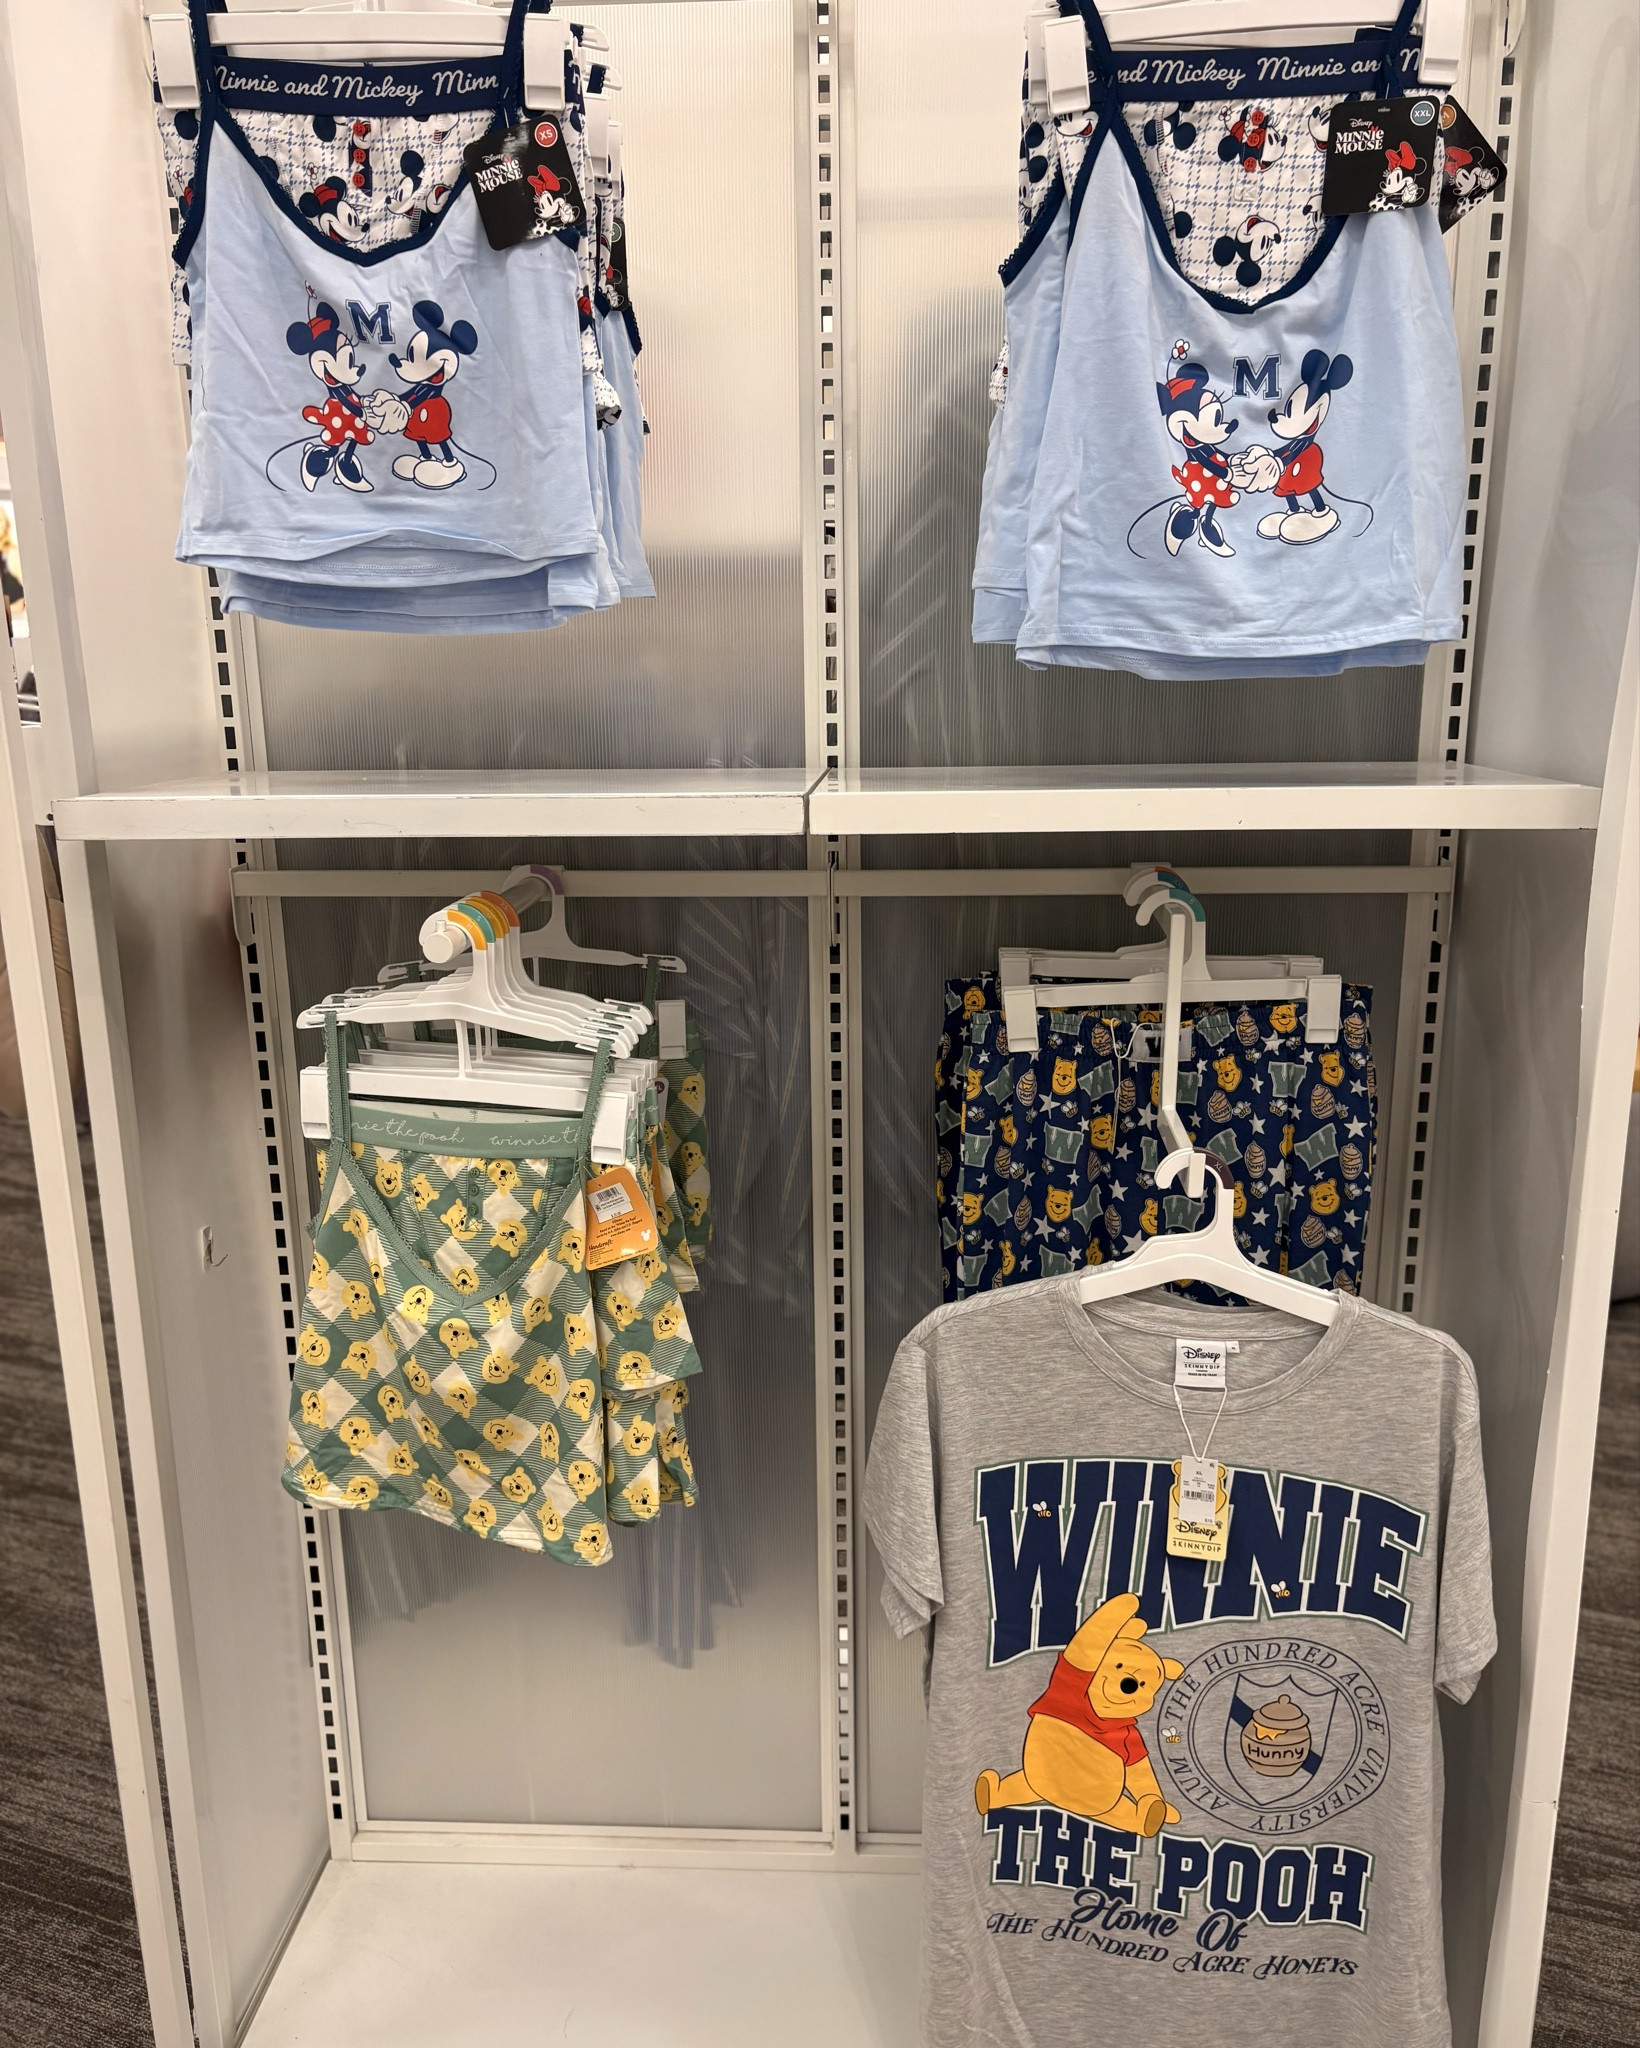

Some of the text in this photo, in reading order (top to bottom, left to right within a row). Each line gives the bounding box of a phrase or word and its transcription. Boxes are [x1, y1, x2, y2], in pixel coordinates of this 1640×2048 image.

[1117, 59, 1149, 84] nd
[1151, 58, 1247, 91] Mickey
[1256, 55, 1347, 81] Minnie
[1350, 60, 1383, 75] an
[284, 74, 329, 97] and
[331, 75, 424, 107] Mickey
[432, 69, 500, 97] Minn
[1349, 118, 1373, 129] Disney
[1414, 109, 1431, 118] XXL
[539, 130, 553, 141] XS
[1334, 140, 1384, 155] MOUSE
[479, 169, 523, 194] MOUSE
[345, 299, 396, 344] M
[1232, 353, 1282, 400] M
[1213, 1105, 1230, 1118] Hunny
[1312, 1099, 1334, 1114] Hunny
[384, 1118, 420, 1136] the
[418, 1126, 465, 1146] pooh
[489, 1133, 562, 1147] winnie
[1213, 1160, 1223, 1172] XL
[1304, 1229, 1324, 1244] Hunny
[1181, 1345, 1221, 1363] Disney
[1173, 1516, 1218, 1541] Disney
[1173, 1540, 1222, 1553] SKINNYDIP
[976, 1457, 1428, 1668] WINNIE
[1165, 1641, 1386, 1832] THE HUNDRED ACRE UNIVERSITY ALUM
[1247, 1743, 1305, 1760] Hunny
[983, 1803, 1375, 1935] THE POOH
[1072, 1887, 1250, 1953] Home Of
[986, 1912, 1360, 1980] THE HUNDRED ACRE HONEYS
